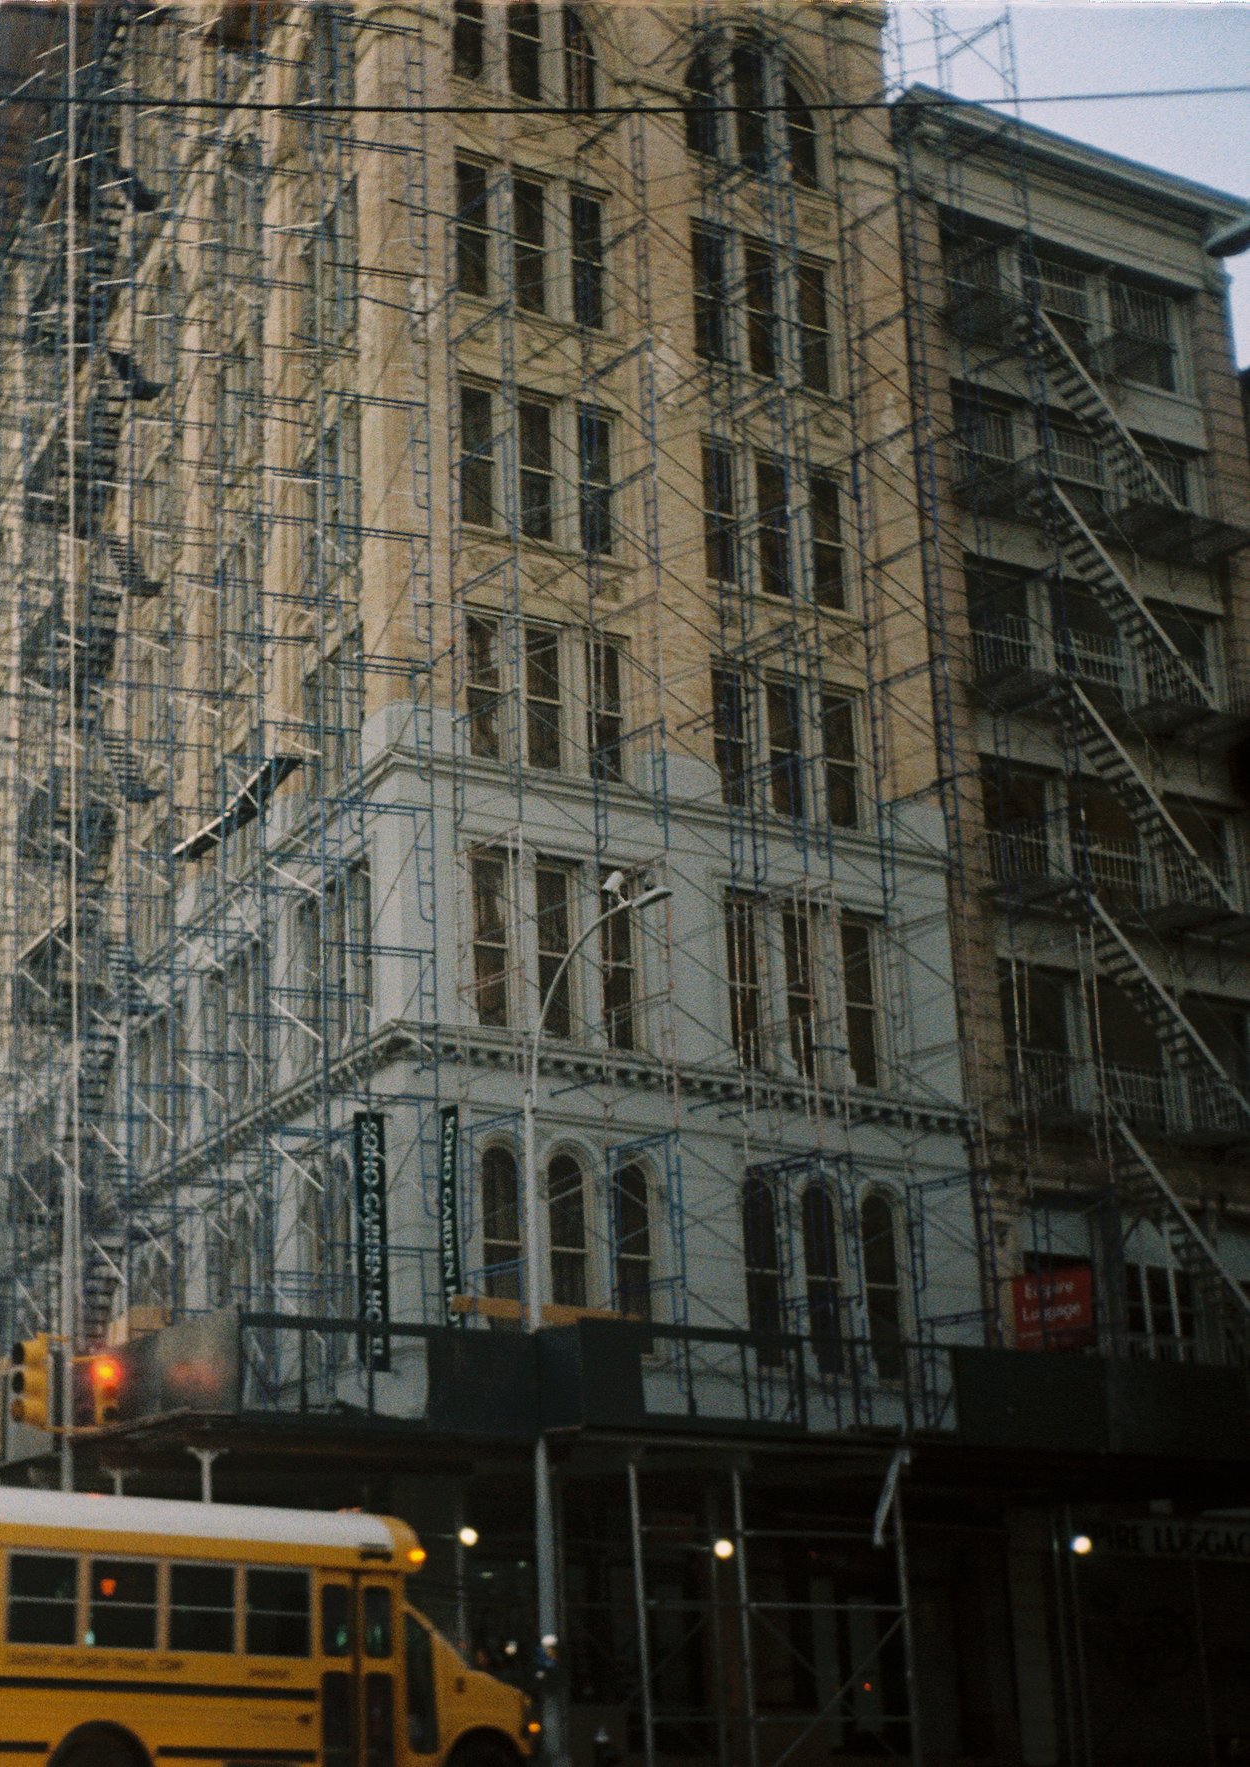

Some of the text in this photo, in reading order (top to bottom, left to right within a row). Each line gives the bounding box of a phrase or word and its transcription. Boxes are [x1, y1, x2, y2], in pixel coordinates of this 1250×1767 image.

[361, 1121, 380, 1187] SOHO
[442, 1116, 455, 1181] SOHO
[442, 1187, 456, 1278] GARDEN
